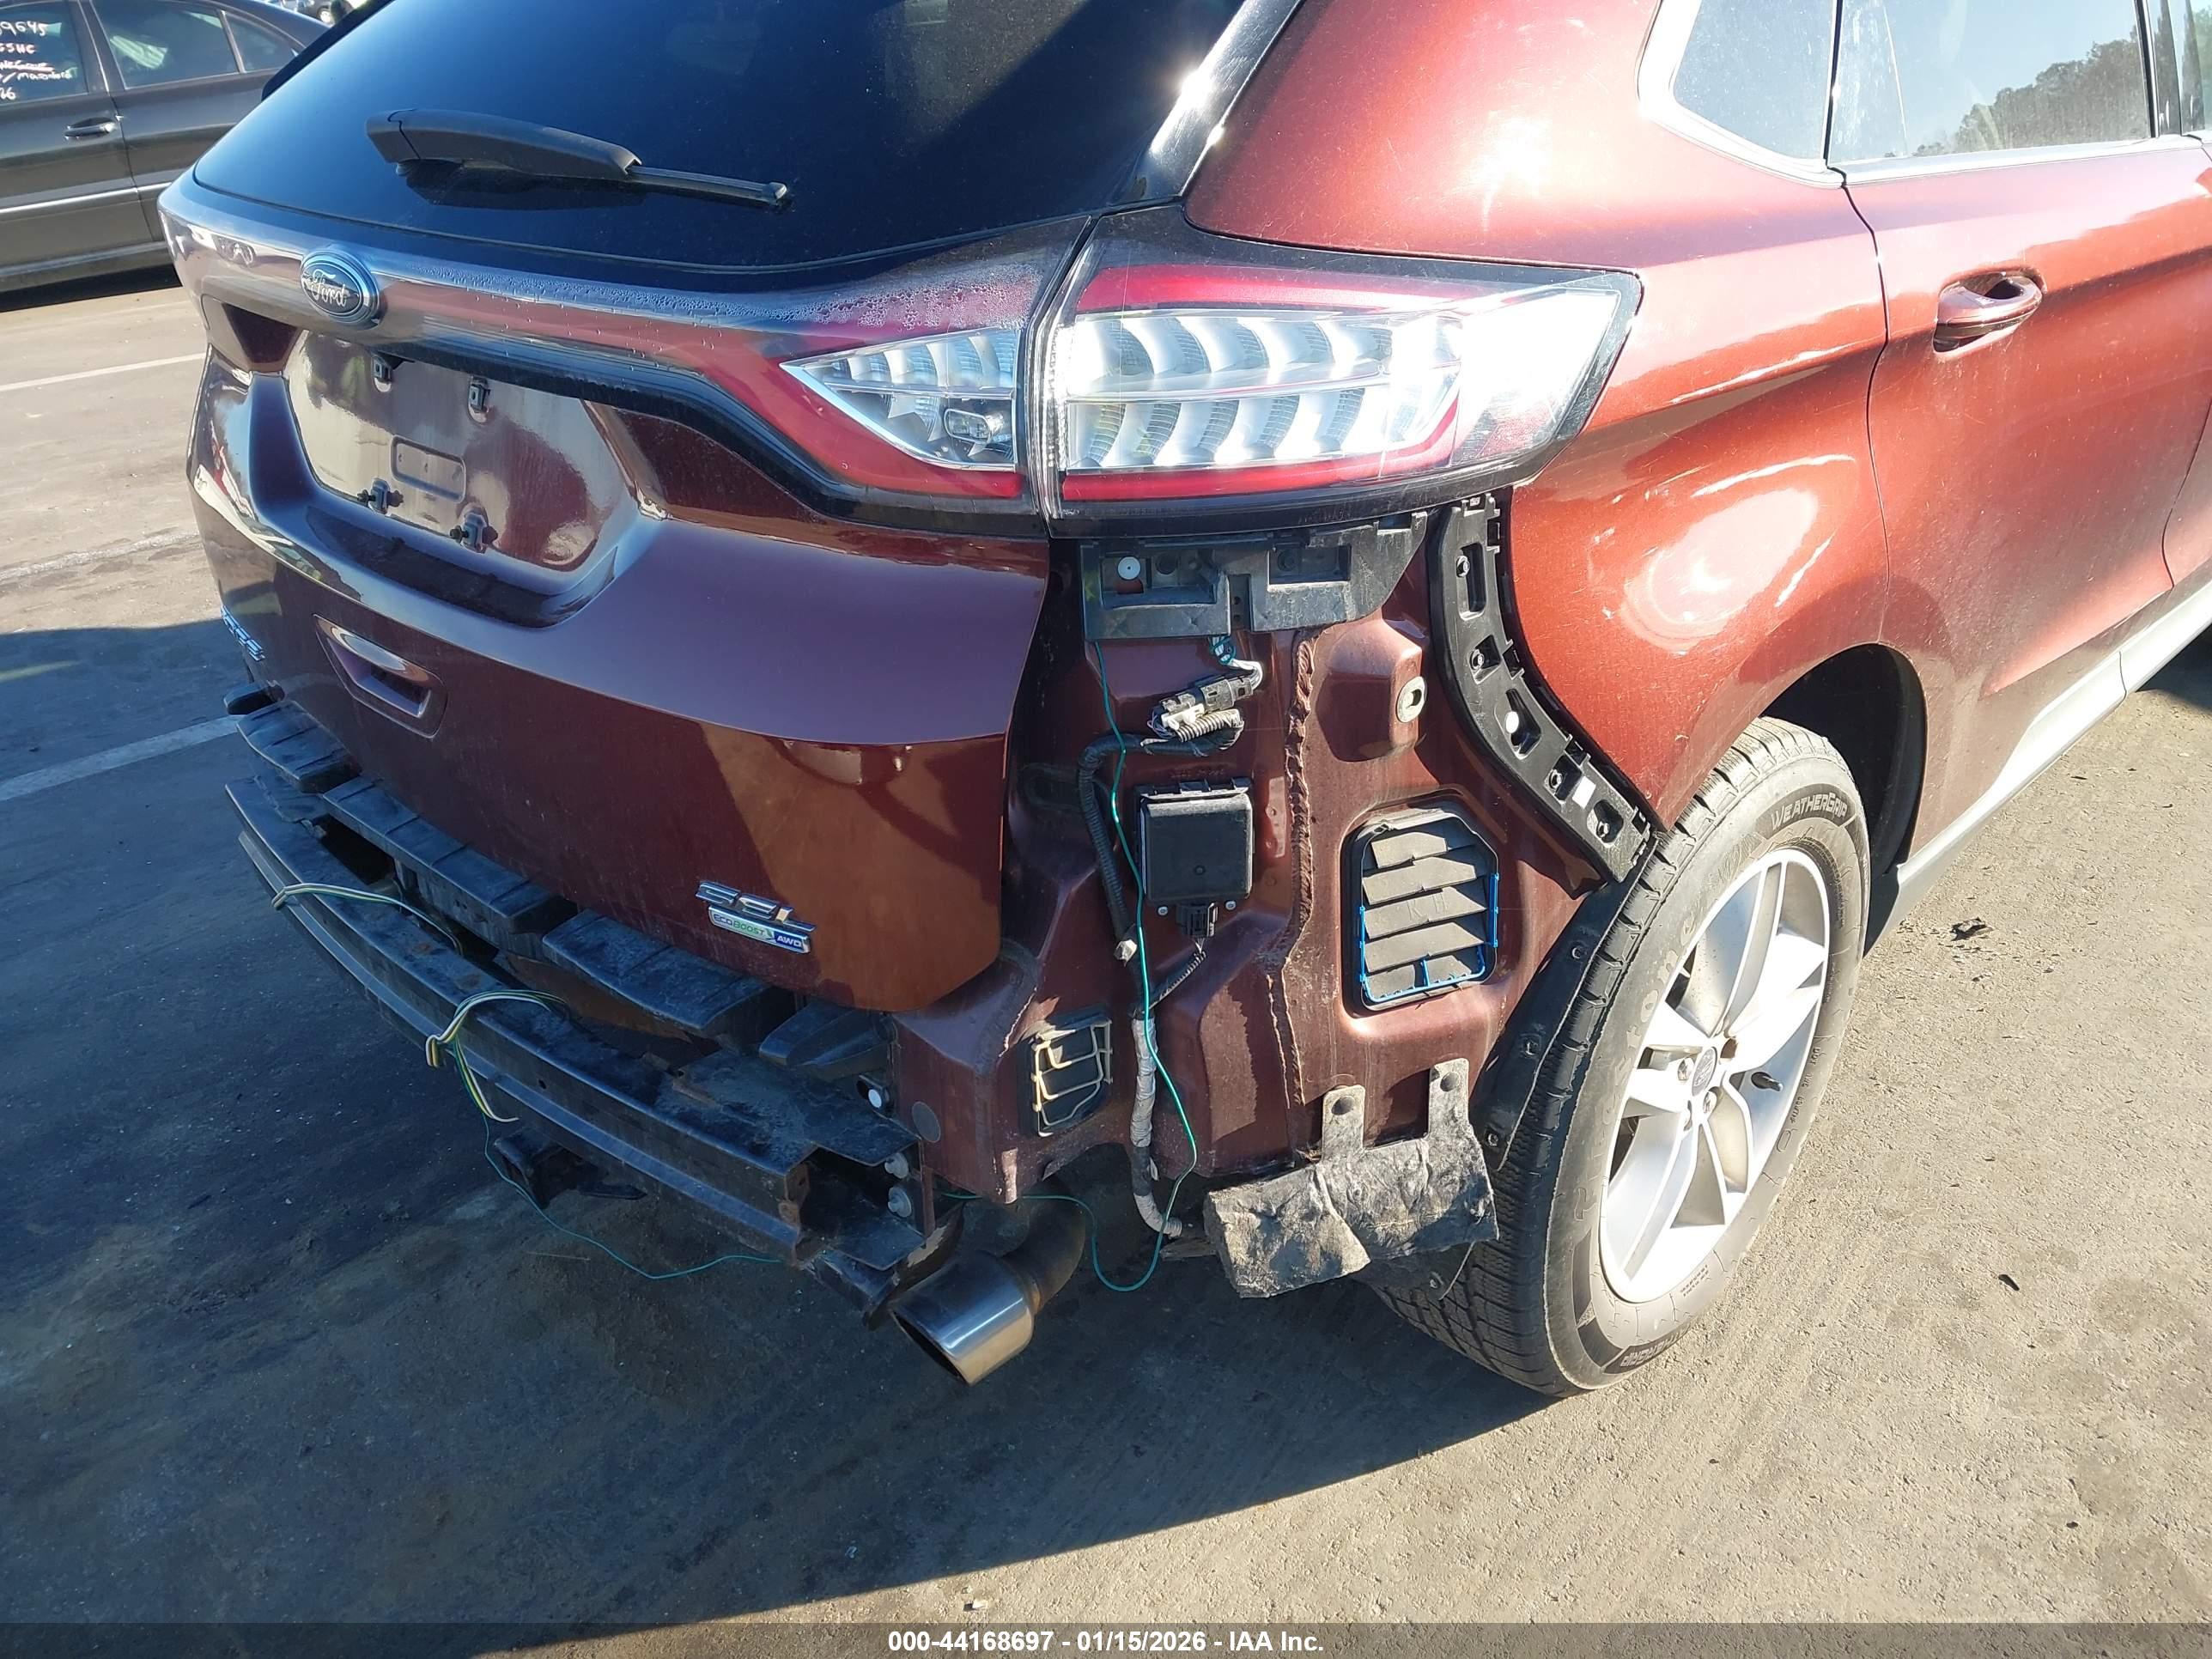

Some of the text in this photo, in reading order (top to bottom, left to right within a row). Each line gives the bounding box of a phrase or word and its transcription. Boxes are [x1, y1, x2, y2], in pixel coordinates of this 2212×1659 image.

[307, 269, 349, 307] Ford
[696, 880, 816, 933] SEL
[776, 934, 803, 948] AWD
